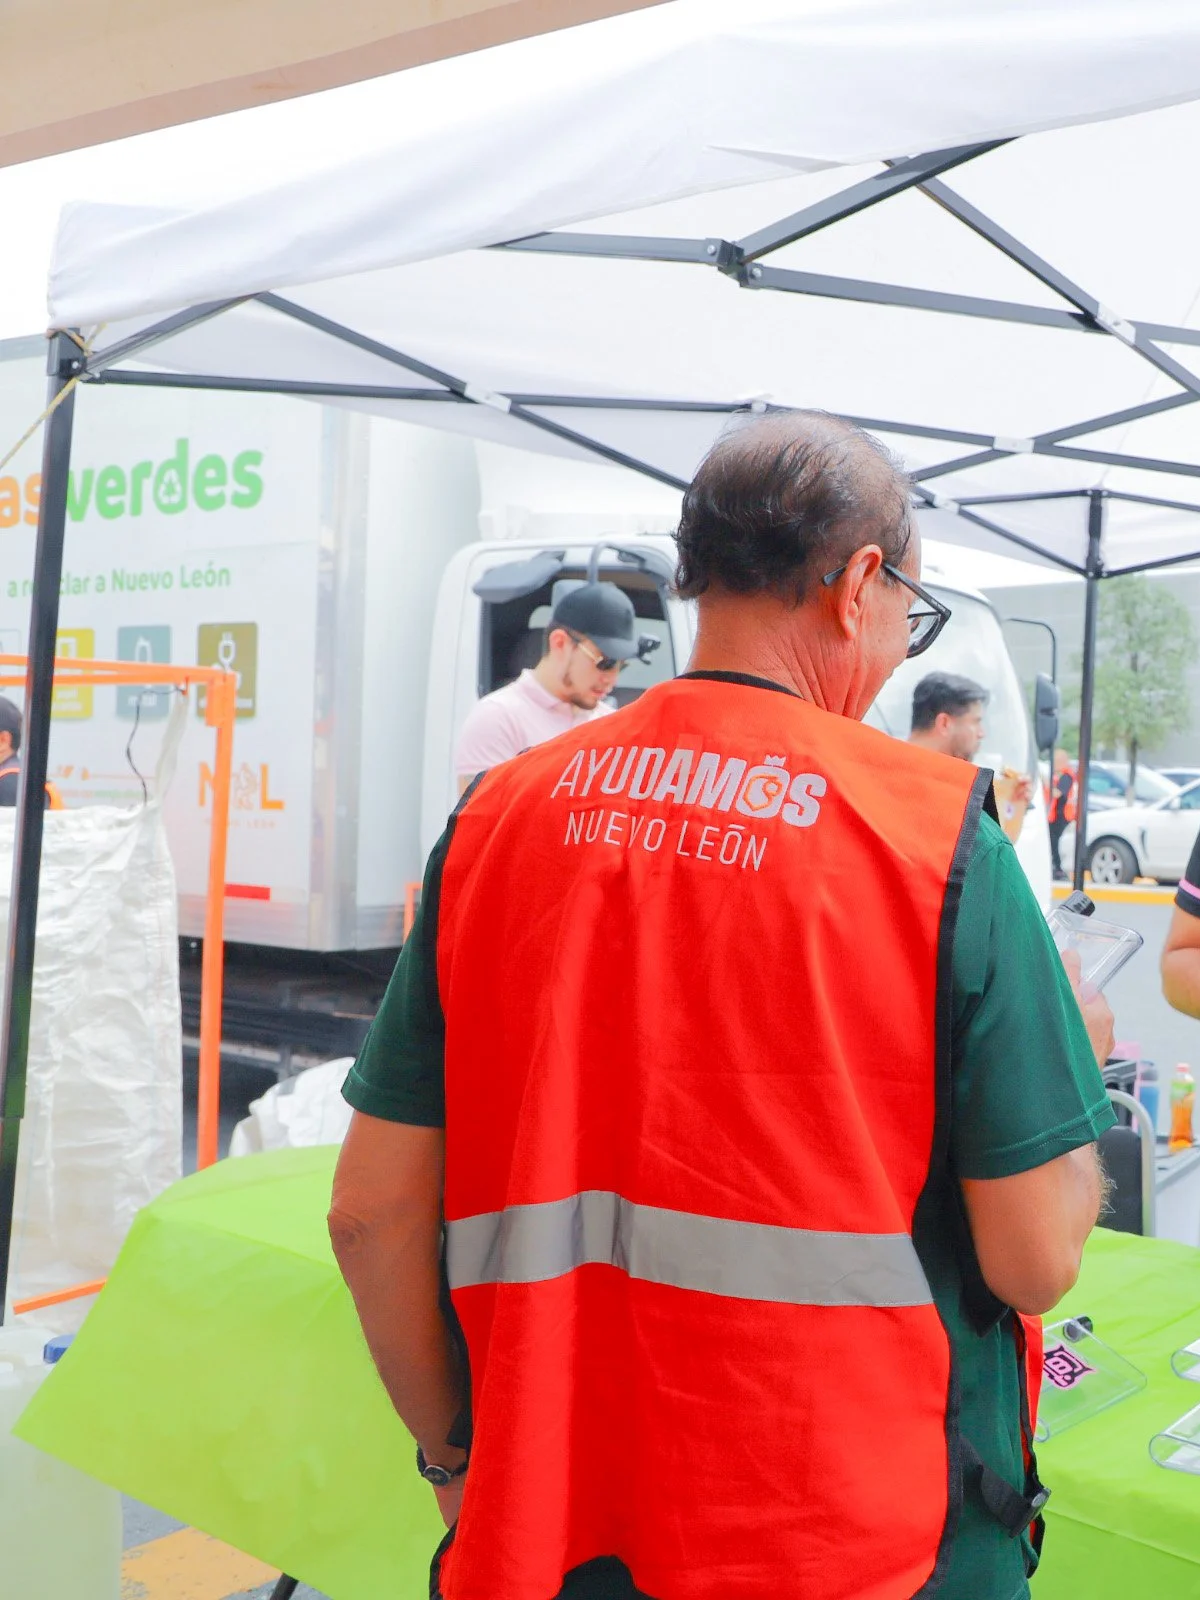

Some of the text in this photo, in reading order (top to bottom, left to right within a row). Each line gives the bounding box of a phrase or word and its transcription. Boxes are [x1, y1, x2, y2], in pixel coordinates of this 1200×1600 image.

[66, 437, 264, 522] verdes
[22, 571, 90, 598] rlar
[95, 574, 106, 593] a
[111, 568, 173, 592] Nuevo
[180, 561, 231, 589] León
[551, 746, 827, 828] AYUDAMOS
[564, 810, 666, 852] NUEVO
